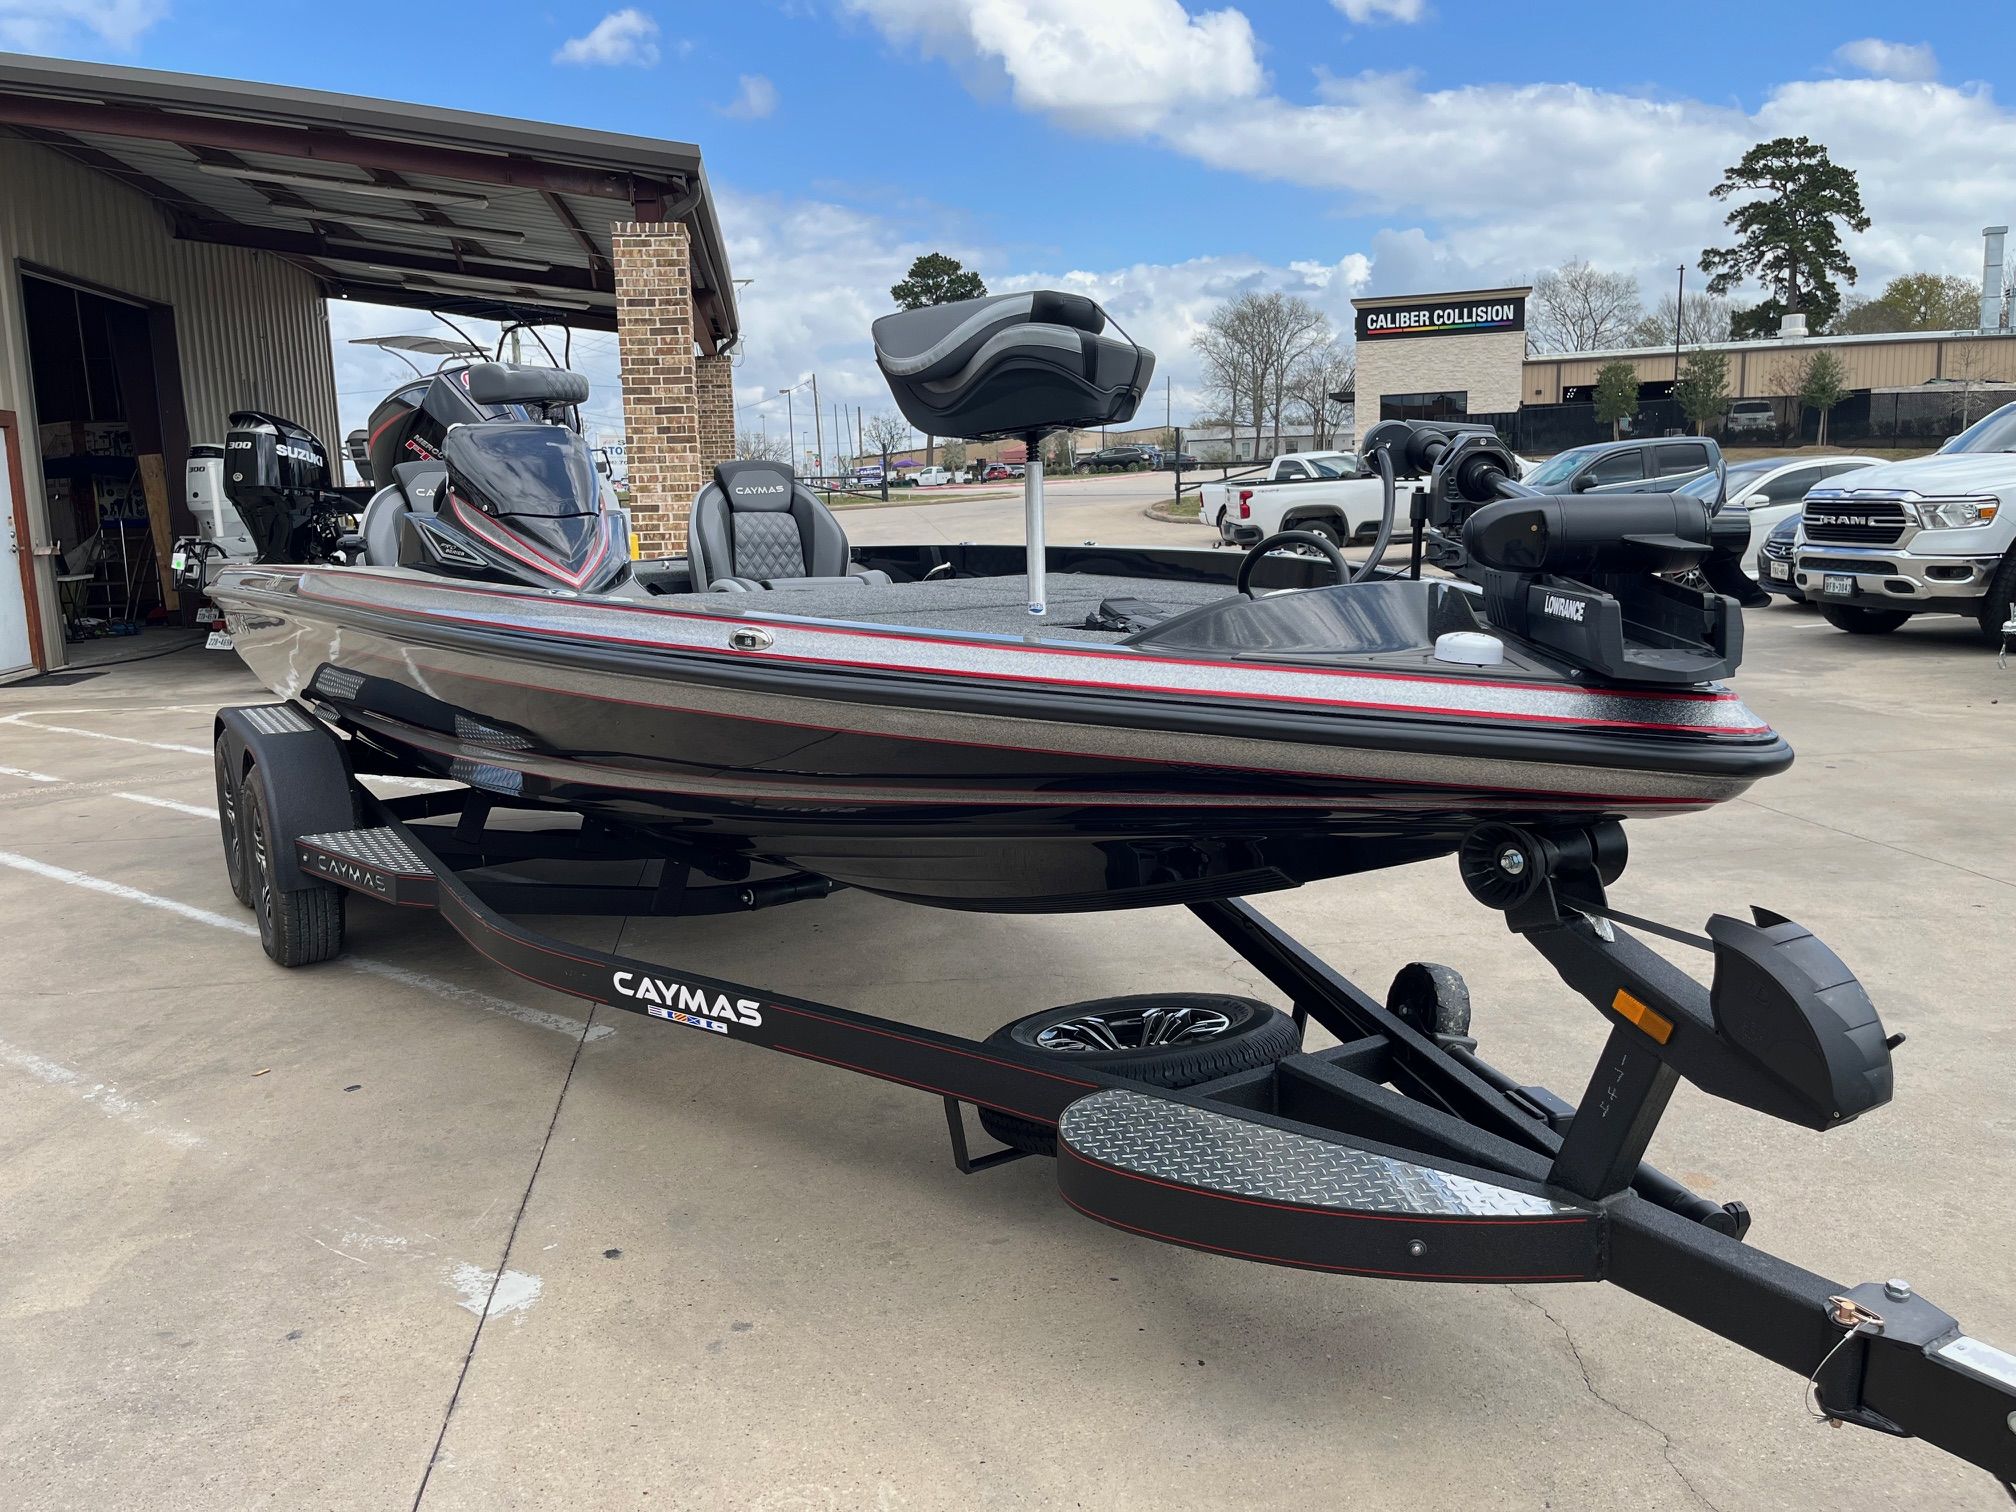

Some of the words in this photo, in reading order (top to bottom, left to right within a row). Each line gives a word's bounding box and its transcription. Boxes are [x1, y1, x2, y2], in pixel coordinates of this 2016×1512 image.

[1366, 311, 1430, 330] CALIBER
[1433, 304, 1514, 325] COLLISION
[228, 441, 252, 450] 300
[276, 444, 324, 467] SUZUKI
[735, 485, 785, 495] CAYMAS
[1823, 515, 1866, 525] RAM
[1544, 594, 1586, 622] LOWRANCE
[318, 855, 386, 892] CAYMAS
[613, 971, 763, 1027] CAYMAS
